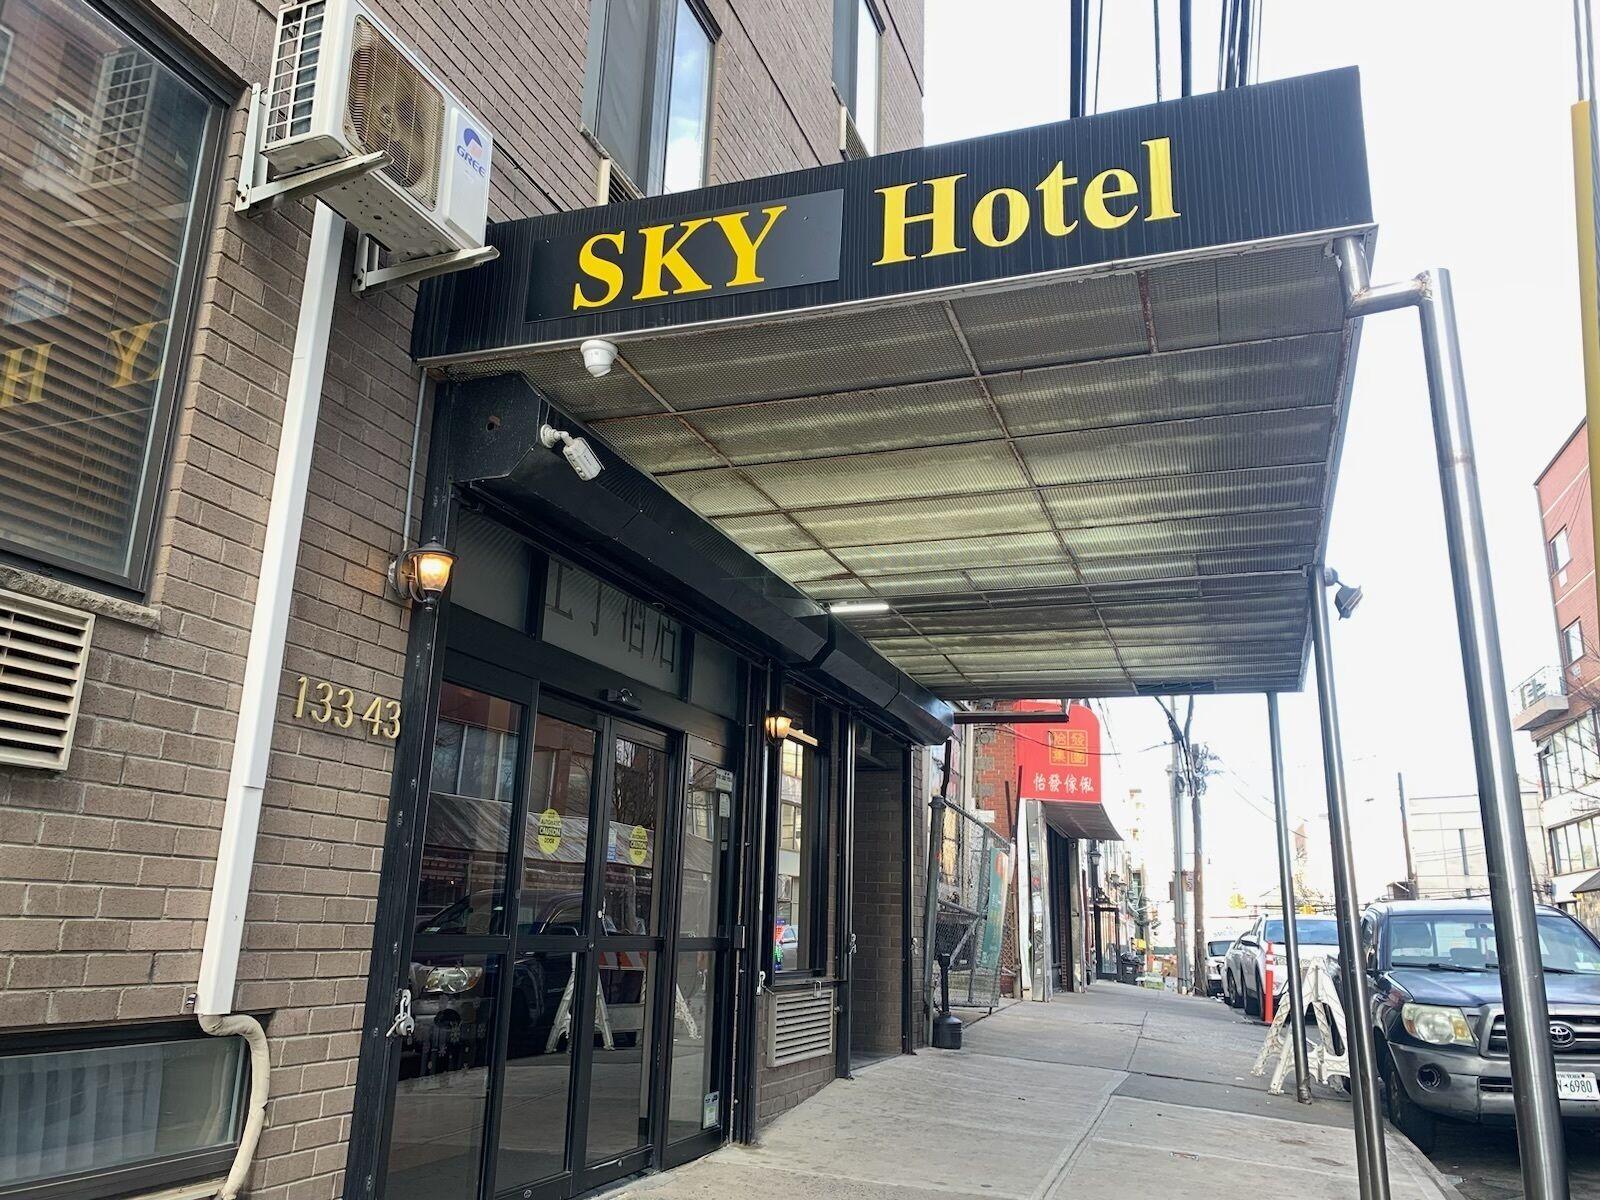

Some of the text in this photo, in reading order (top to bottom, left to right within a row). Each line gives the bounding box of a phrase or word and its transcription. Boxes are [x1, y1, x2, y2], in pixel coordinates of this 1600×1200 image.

[456, 144, 486, 178] GREE
[572, 136, 1181, 311] SKY Hotel
